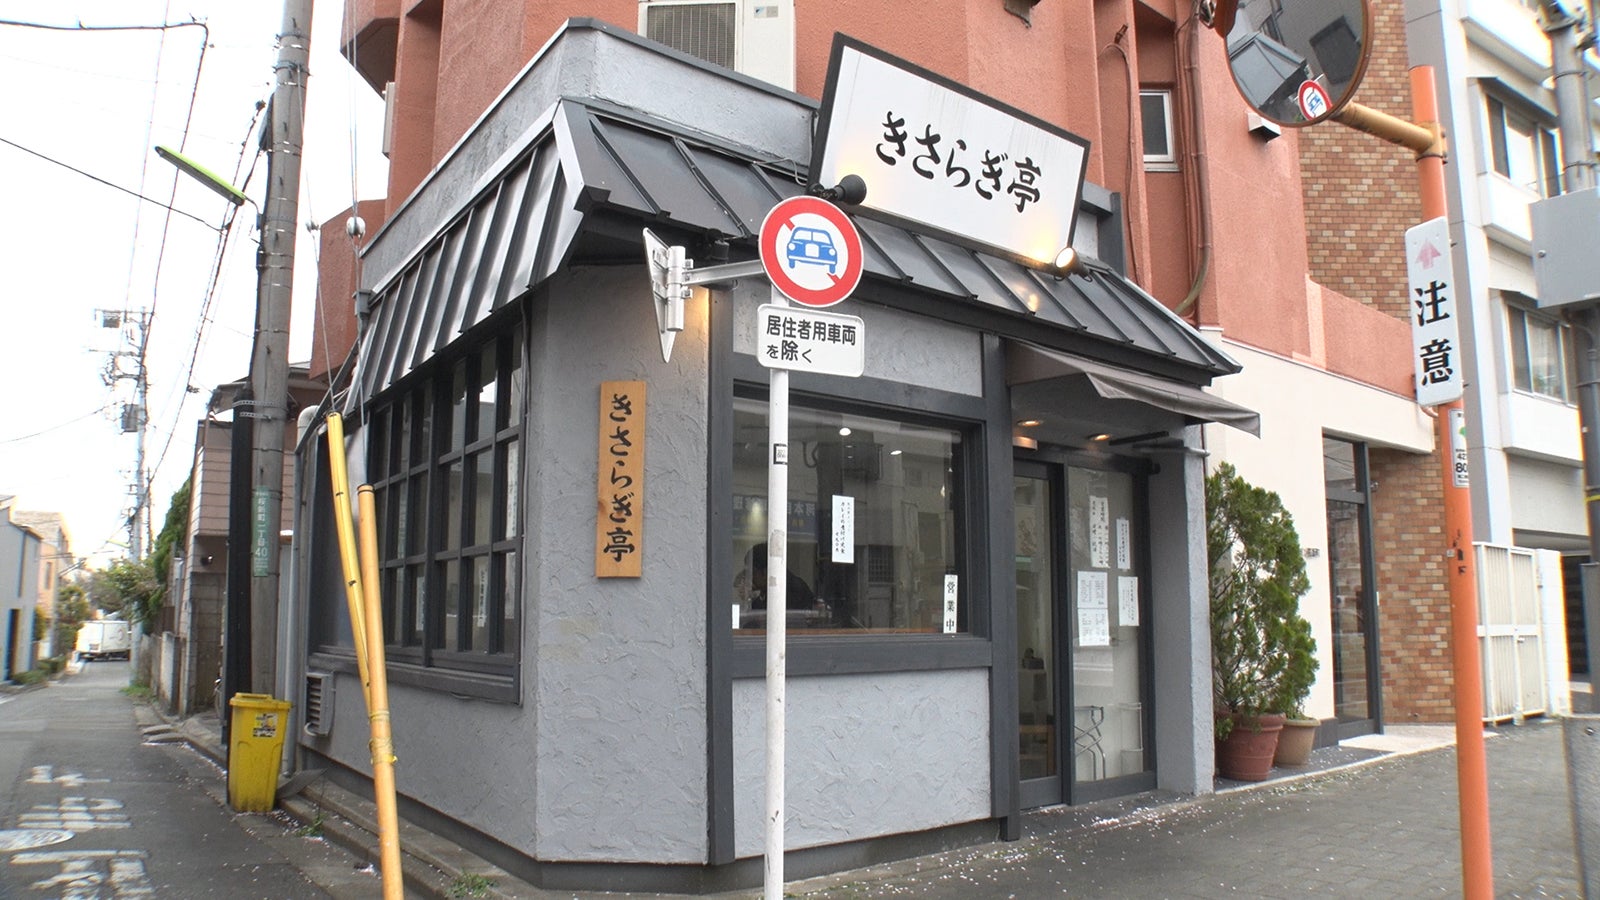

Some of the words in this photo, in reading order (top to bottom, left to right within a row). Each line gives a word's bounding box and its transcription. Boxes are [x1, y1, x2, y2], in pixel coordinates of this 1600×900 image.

[876, 111, 1042, 213] きさらぎ亭
[766, 314, 856, 346] 居住者用車両
[766, 340, 812, 363] を除く
[1414, 280, 1454, 386] 注意
[603, 393, 635, 562] きさらぎ亭
[255, 547, 268, 557] 40
[946, 581, 956, 631] 営業中
